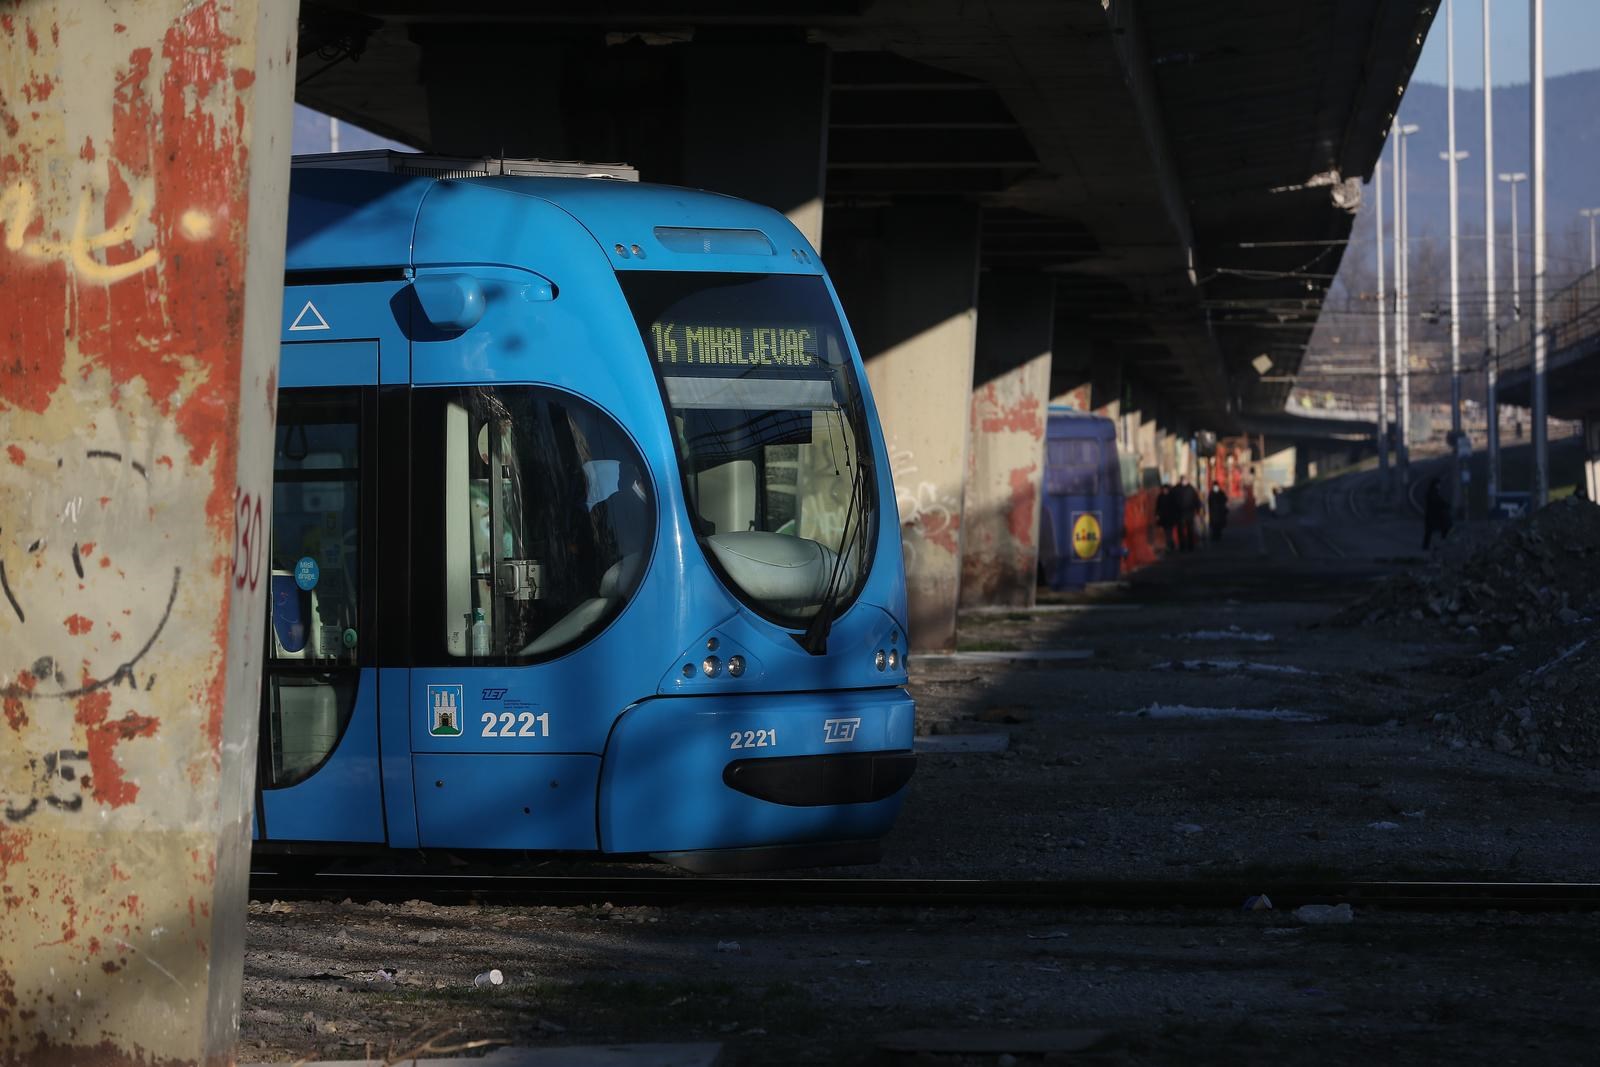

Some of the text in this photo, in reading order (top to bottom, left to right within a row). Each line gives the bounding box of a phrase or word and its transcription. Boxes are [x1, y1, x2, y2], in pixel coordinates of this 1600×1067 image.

[651, 322, 812, 366] 14 MIHALJEVAC
[482, 688, 508, 701] ZET
[481, 711, 549, 737] 2221
[823, 717, 861, 743] ZET
[730, 728, 777, 750] 2221
